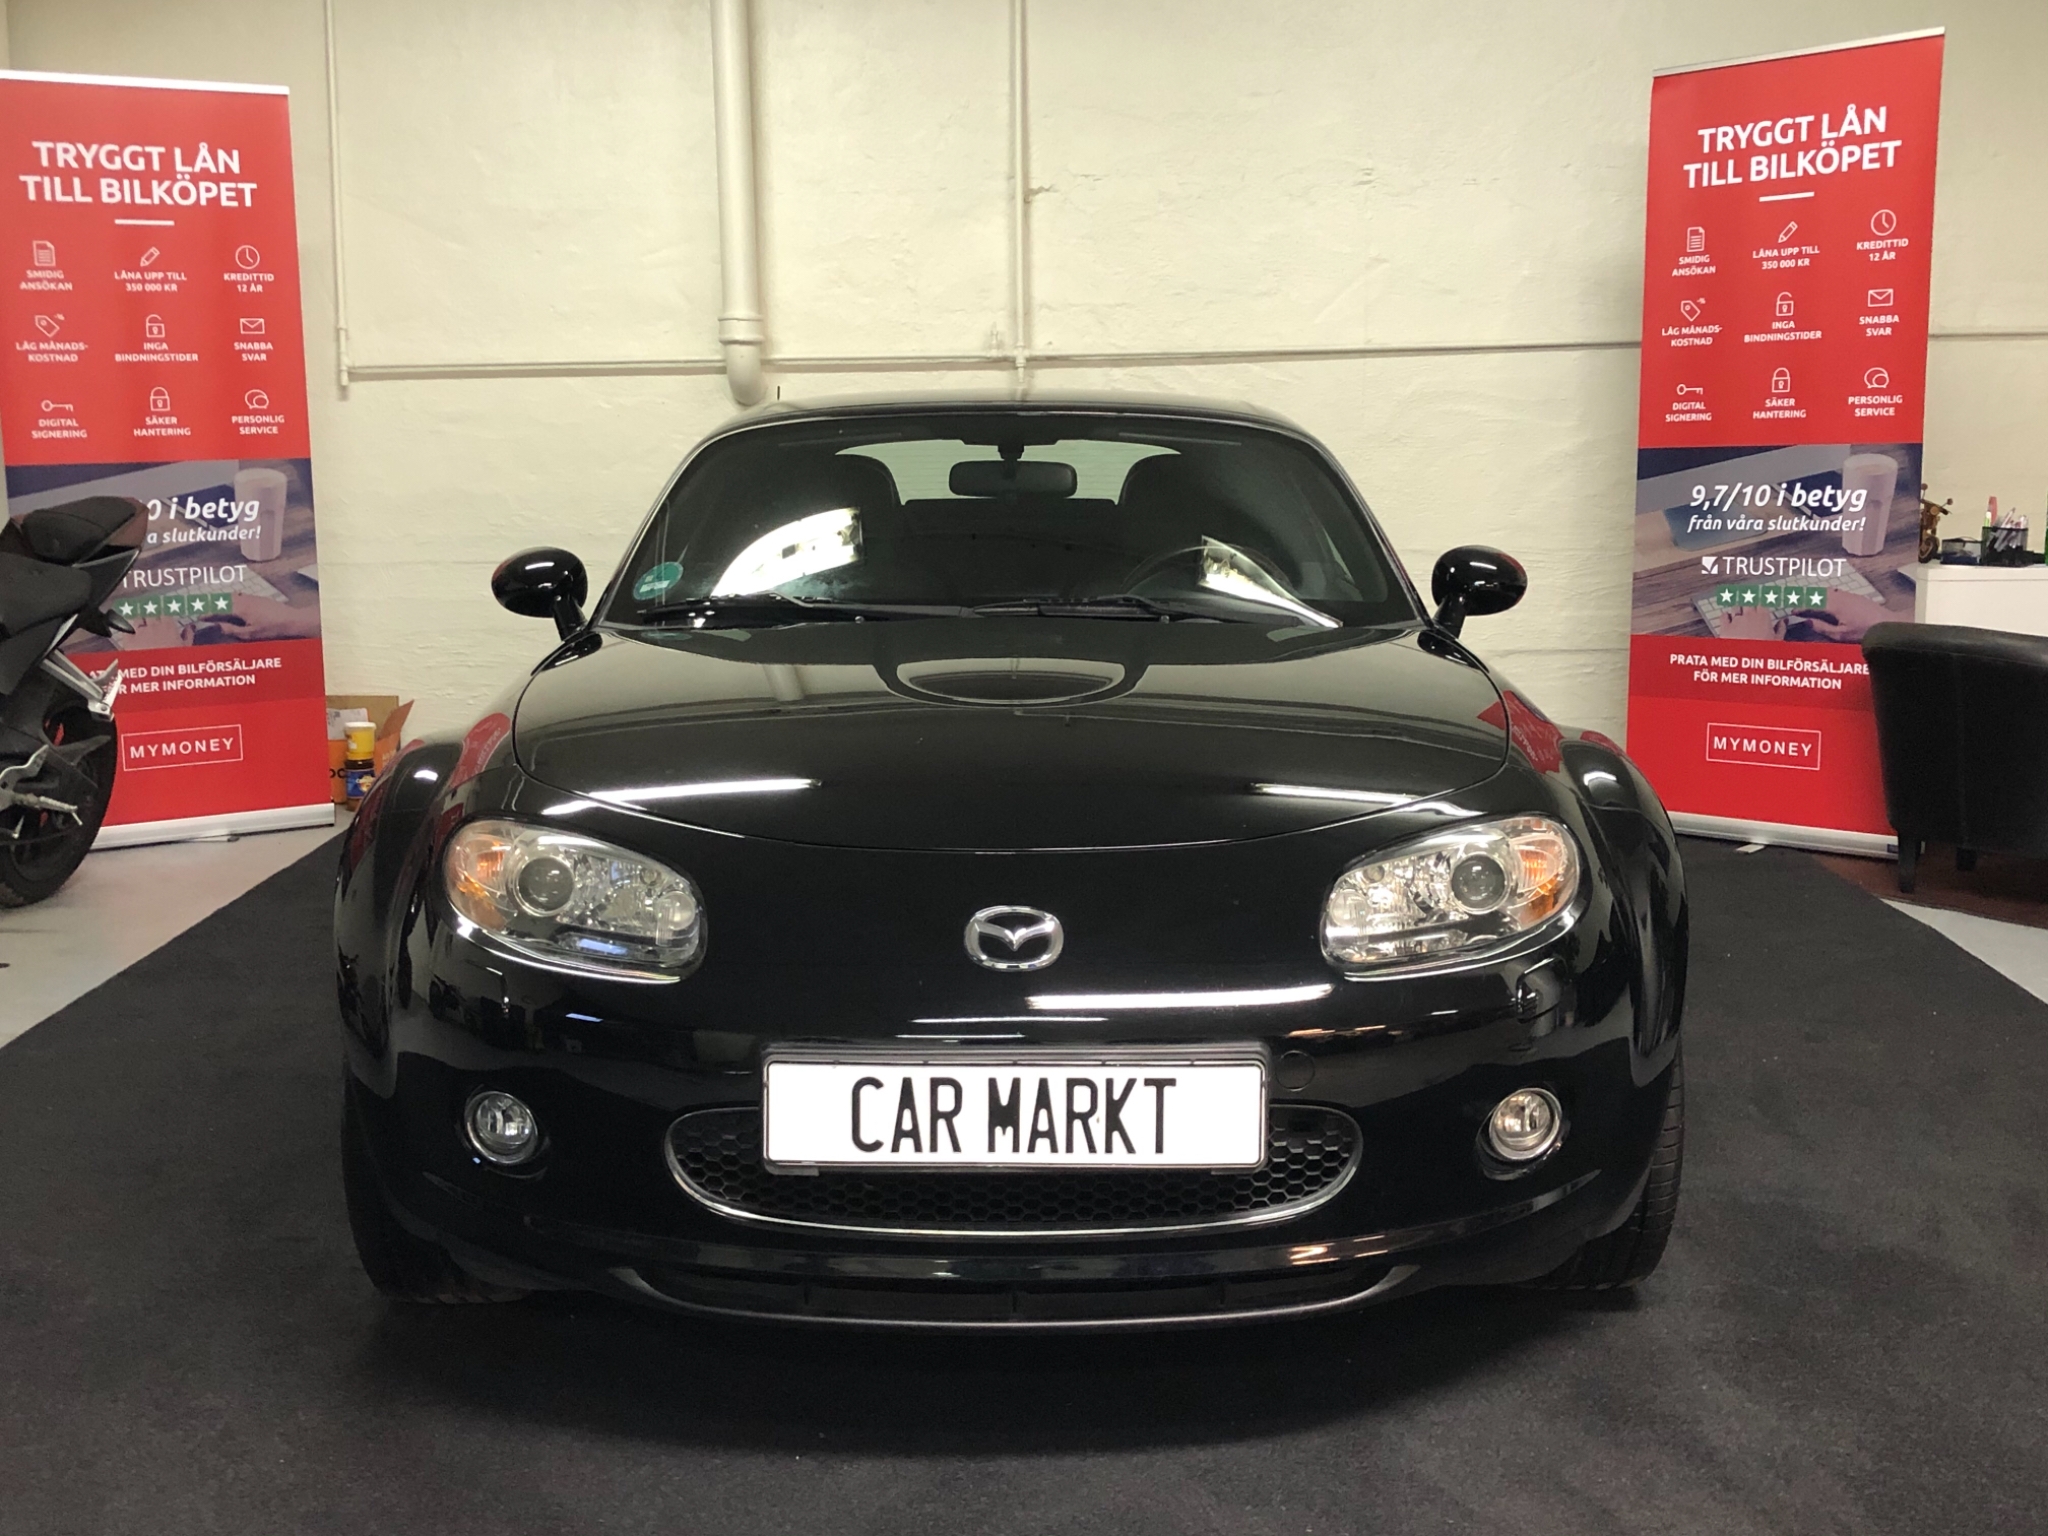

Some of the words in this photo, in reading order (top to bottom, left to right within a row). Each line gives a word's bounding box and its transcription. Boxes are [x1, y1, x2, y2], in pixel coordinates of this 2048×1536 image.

[1698, 115, 1815, 154] TRYGGT
[1821, 103, 1887, 139] LÅN
[32, 140, 166, 171] TRYGGT
[174, 142, 240, 174] LÅN
[1683, 161, 1743, 189] TILL
[1750, 140, 1902, 182] BILKÖPET
[19, 175, 93, 203] TILL
[100, 174, 257, 207] BILKÖPET
[1856, 238, 1909, 250] KREDITTID
[1752, 247, 1776, 259] LÅNA
[1777, 246, 1799, 257] UPP
[1801, 245, 1820, 255] TILL
[1868, 252, 1880, 262] 12
[1882, 249, 1896, 261] ÅR
[1678, 254, 1710, 265] SMIDIG
[1761, 259, 1778, 270] 350
[1780, 258, 1796, 269] 000
[1797, 257, 1810, 268] KR
[26, 269, 64, 279] SMIDIG
[114, 270, 142, 281] LÅNA
[144, 271, 164, 281] UPP
[166, 272, 187, 281] TILL
[1672, 264, 1716, 277] ANSÖKAN
[223, 272, 275, 282] KREDITTID
[20, 279, 72, 291] ANSÖKAN
[125, 282, 142, 292] 350
[143, 282, 162, 292] 000
[164, 283, 178, 292] KR
[237, 284, 248, 293] 12
[250, 281, 264, 293] ÅR
[1772, 320, 1795, 330] INGA
[1859, 314, 1900, 325] SNABBA
[1661, 325, 1680, 336] LÅG
[1682, 324, 1723, 336] MÅNADS-
[1865, 326, 1892, 337] SVAR
[1671, 336, 1713, 347] KOSTNAD
[1743, 330, 1822, 343] BINDNINGSTIDER
[15, 340, 37, 350] LÅG
[39, 340, 89, 351] MÅNADS-
[143, 342, 169, 351] INGA
[233, 341, 273, 351] SNABBA
[28, 353, 78, 362] KOSTNAD
[114, 353, 199, 362] BINDNINGSTIDER
[241, 352, 267, 362] SVAR
[1672, 401, 1706, 411] DIGITAL
[1765, 396, 1796, 408] SÄKER
[1848, 394, 1903, 406] PERSONLIG
[1665, 412, 1712, 423] SIGNERING
[1752, 408, 1807, 419] HANTERING
[1854, 406, 1895, 417] SERVICE
[38, 418, 79, 428] DIGITAL
[145, 414, 178, 425] SÄKER
[231, 414, 285, 424] PERSONLIG
[31, 429, 87, 439] SIGNERING
[133, 426, 191, 437] HANTERING
[239, 424, 279, 435] SERVICE
[1690, 482, 1772, 512] 9,7/10
[1776, 483, 1788, 507] i
[1791, 482, 1868, 512] betyg
[169, 497, 179, 520] i
[184, 496, 260, 523] betyg
[1687, 514, 1723, 534] från
[1726, 514, 1764, 531] våra
[1767, 514, 1866, 533] slutkunder!
[162, 526, 262, 544] slutkunder!
[1722, 556, 1847, 578] TRUSTPILOT
[118, 667, 148, 680] MED
[151, 665, 175, 677] DIN
[178, 657, 282, 675] BILFÖRSÄLJARE
[1670, 653, 1709, 667] PRATA
[1710, 655, 1739, 668] MED
[1741, 657, 1765, 670] DIN
[1767, 656, 1870, 676] BILFÖRSÄLJARE
[130, 682, 160, 694] MER
[163, 674, 256, 691] INFORMATION
[1693, 668, 1719, 683] FÖR
[1720, 672, 1748, 685] MER
[1750, 673, 1842, 690] INFORMATION
[130, 737, 234, 759] MYMONEY
[1713, 736, 1812, 758] MYMONEY
[850, 1077, 964, 1153] CAR
[987, 1077, 1177, 1154] MARKT
